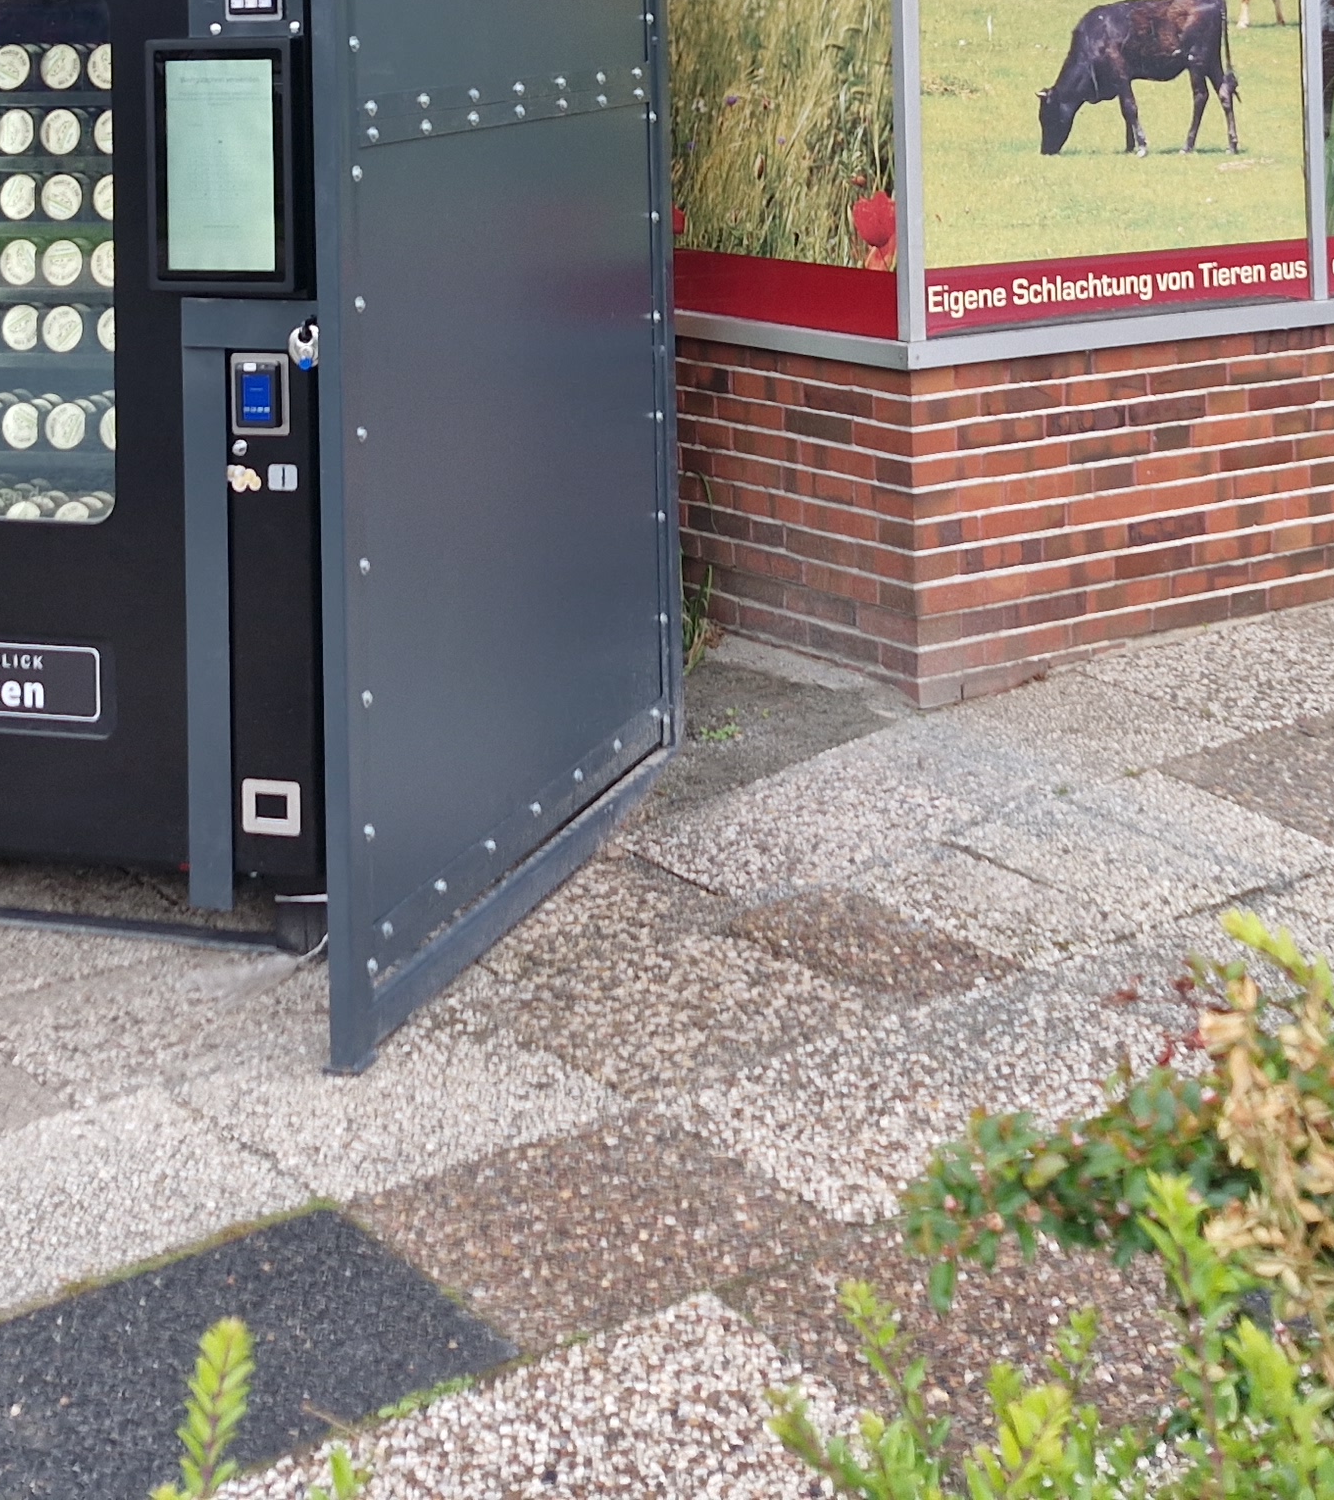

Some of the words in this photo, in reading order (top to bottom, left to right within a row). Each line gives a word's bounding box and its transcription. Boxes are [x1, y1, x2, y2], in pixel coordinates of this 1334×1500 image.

[927, 284, 1007, 319] Eigene
[1012, 272, 1152, 306] Schlachtung
[1156, 270, 1194, 291] von
[1198, 262, 1266, 288] Tieren
[1269, 260, 1308, 282] aus
